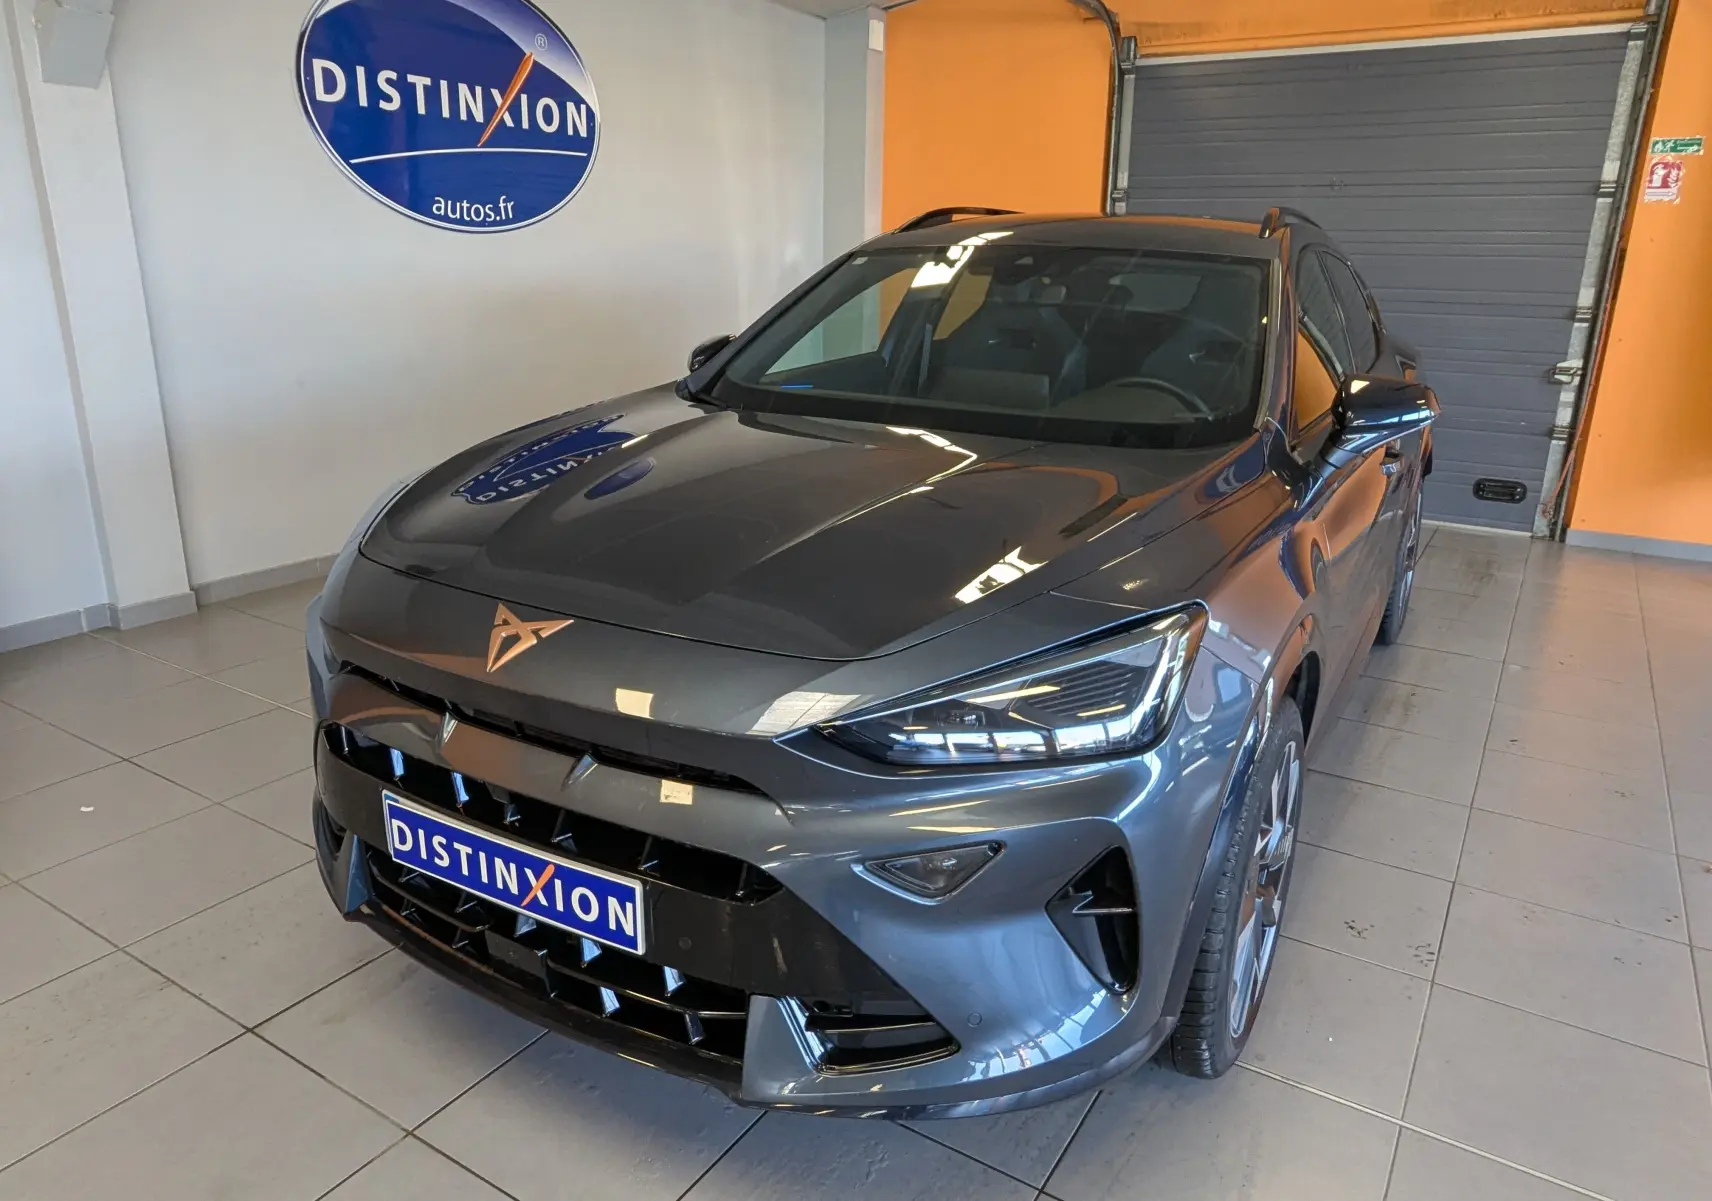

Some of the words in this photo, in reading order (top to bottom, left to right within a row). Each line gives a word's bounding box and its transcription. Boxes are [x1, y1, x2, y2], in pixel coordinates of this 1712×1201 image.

[312, 52, 588, 147] DISTINXION
[432, 196, 514, 222] autos.fr
[391, 818, 635, 937] DISTINXION
